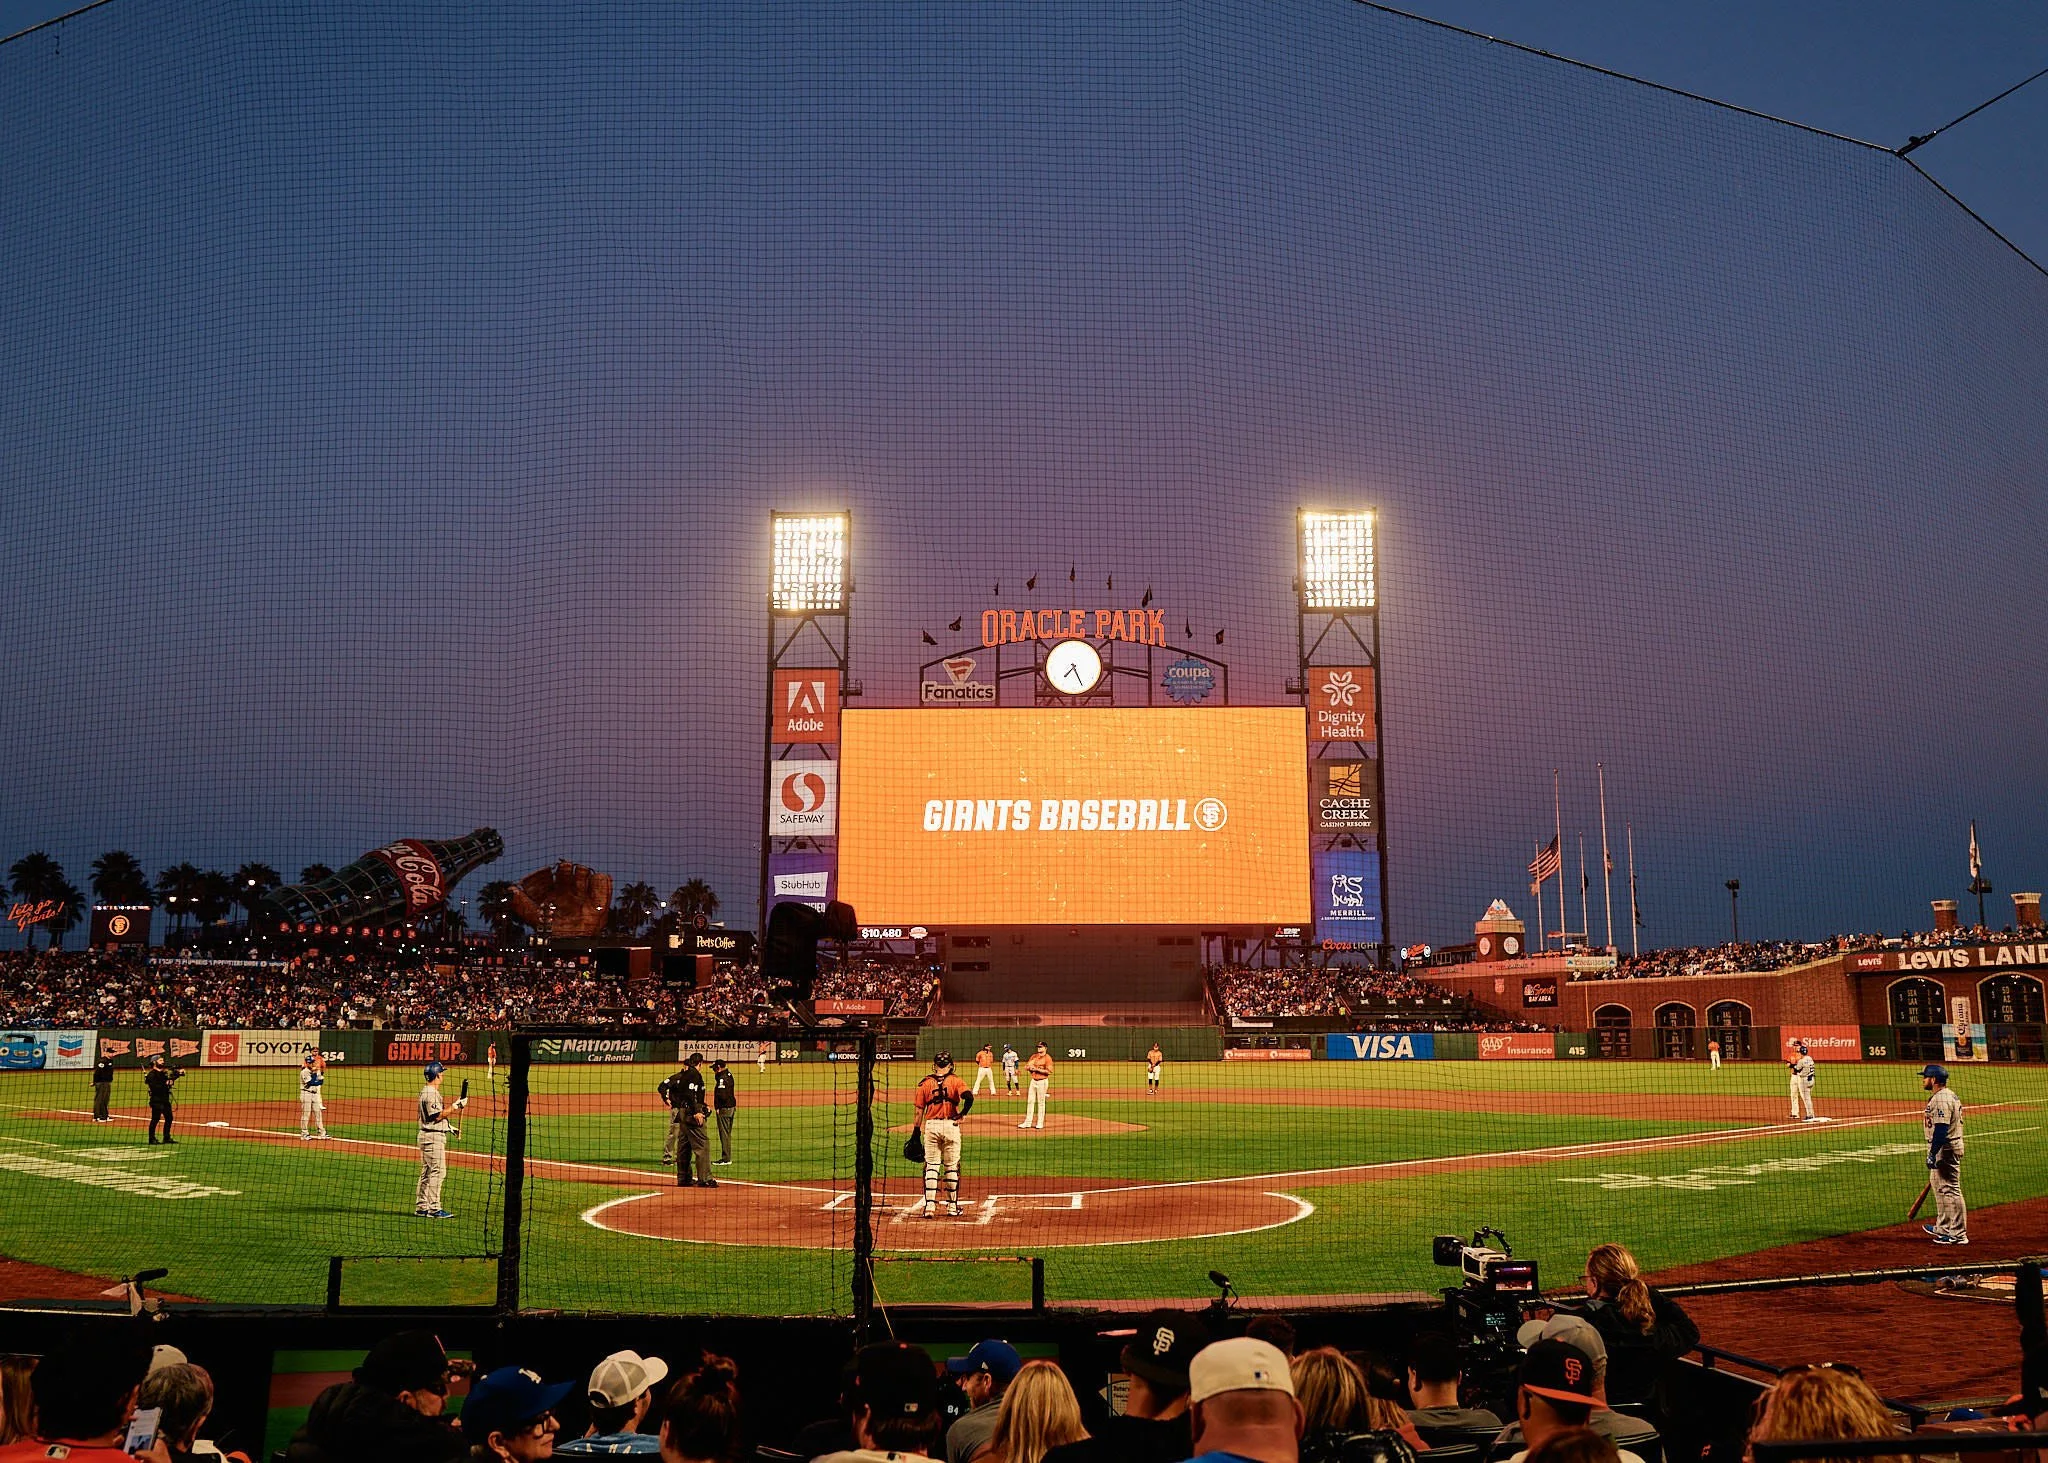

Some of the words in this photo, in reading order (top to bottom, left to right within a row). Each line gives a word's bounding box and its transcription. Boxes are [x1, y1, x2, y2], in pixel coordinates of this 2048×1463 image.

[982, 609, 1086, 647] ORACLE
[1095, 609, 1166, 647] PARK
[1168, 667, 1211, 681] coupa
[924, 684, 994, 699] Fanatics
[787, 718, 824, 731] Adobe
[1318, 711, 1365, 726] Dignity
[1321, 725, 1364, 737] Health
[1319, 799, 1371, 809] CACHE
[780, 814, 825, 824] SAFEWAY
[923, 799, 1032, 831] GIANTS
[1038, 799, 1191, 831] BASEBALL
[1321, 809, 1369, 820] CREEK
[781, 880, 821, 889] StubHub
[8, 902, 35, 920] Let's
[34, 899, 54, 915] go
[16, 901, 65, 933] Giants!
[861, 928, 902, 939] $10,480
[697, 936, 714, 948] Peet's
[715, 937, 736, 949] Coffee
[1322, 938, 1352, 950] Coors
[1533, 984, 1556, 996] Sports
[246, 1042, 313, 1054] TOYOTA
[387, 1042, 435, 1061] GAME
[439, 1042, 462, 1061] UP
[562, 1039, 638, 1052] National
[1347, 1036, 1414, 1058] VISA
[1507, 1046, 1552, 1055] Insurance
[1568, 1046, 1586, 1055] 415
[1868, 1046, 1887, 1056] 365
[322, 1051, 345, 1061] 354
[588, 1053, 602, 1061] Car
[604, 1053, 634, 1061] Rental
[780, 1050, 799, 1059] 399
[1068, 1048, 1086, 1058] 391
[947, 1404, 959, 1416] 84
